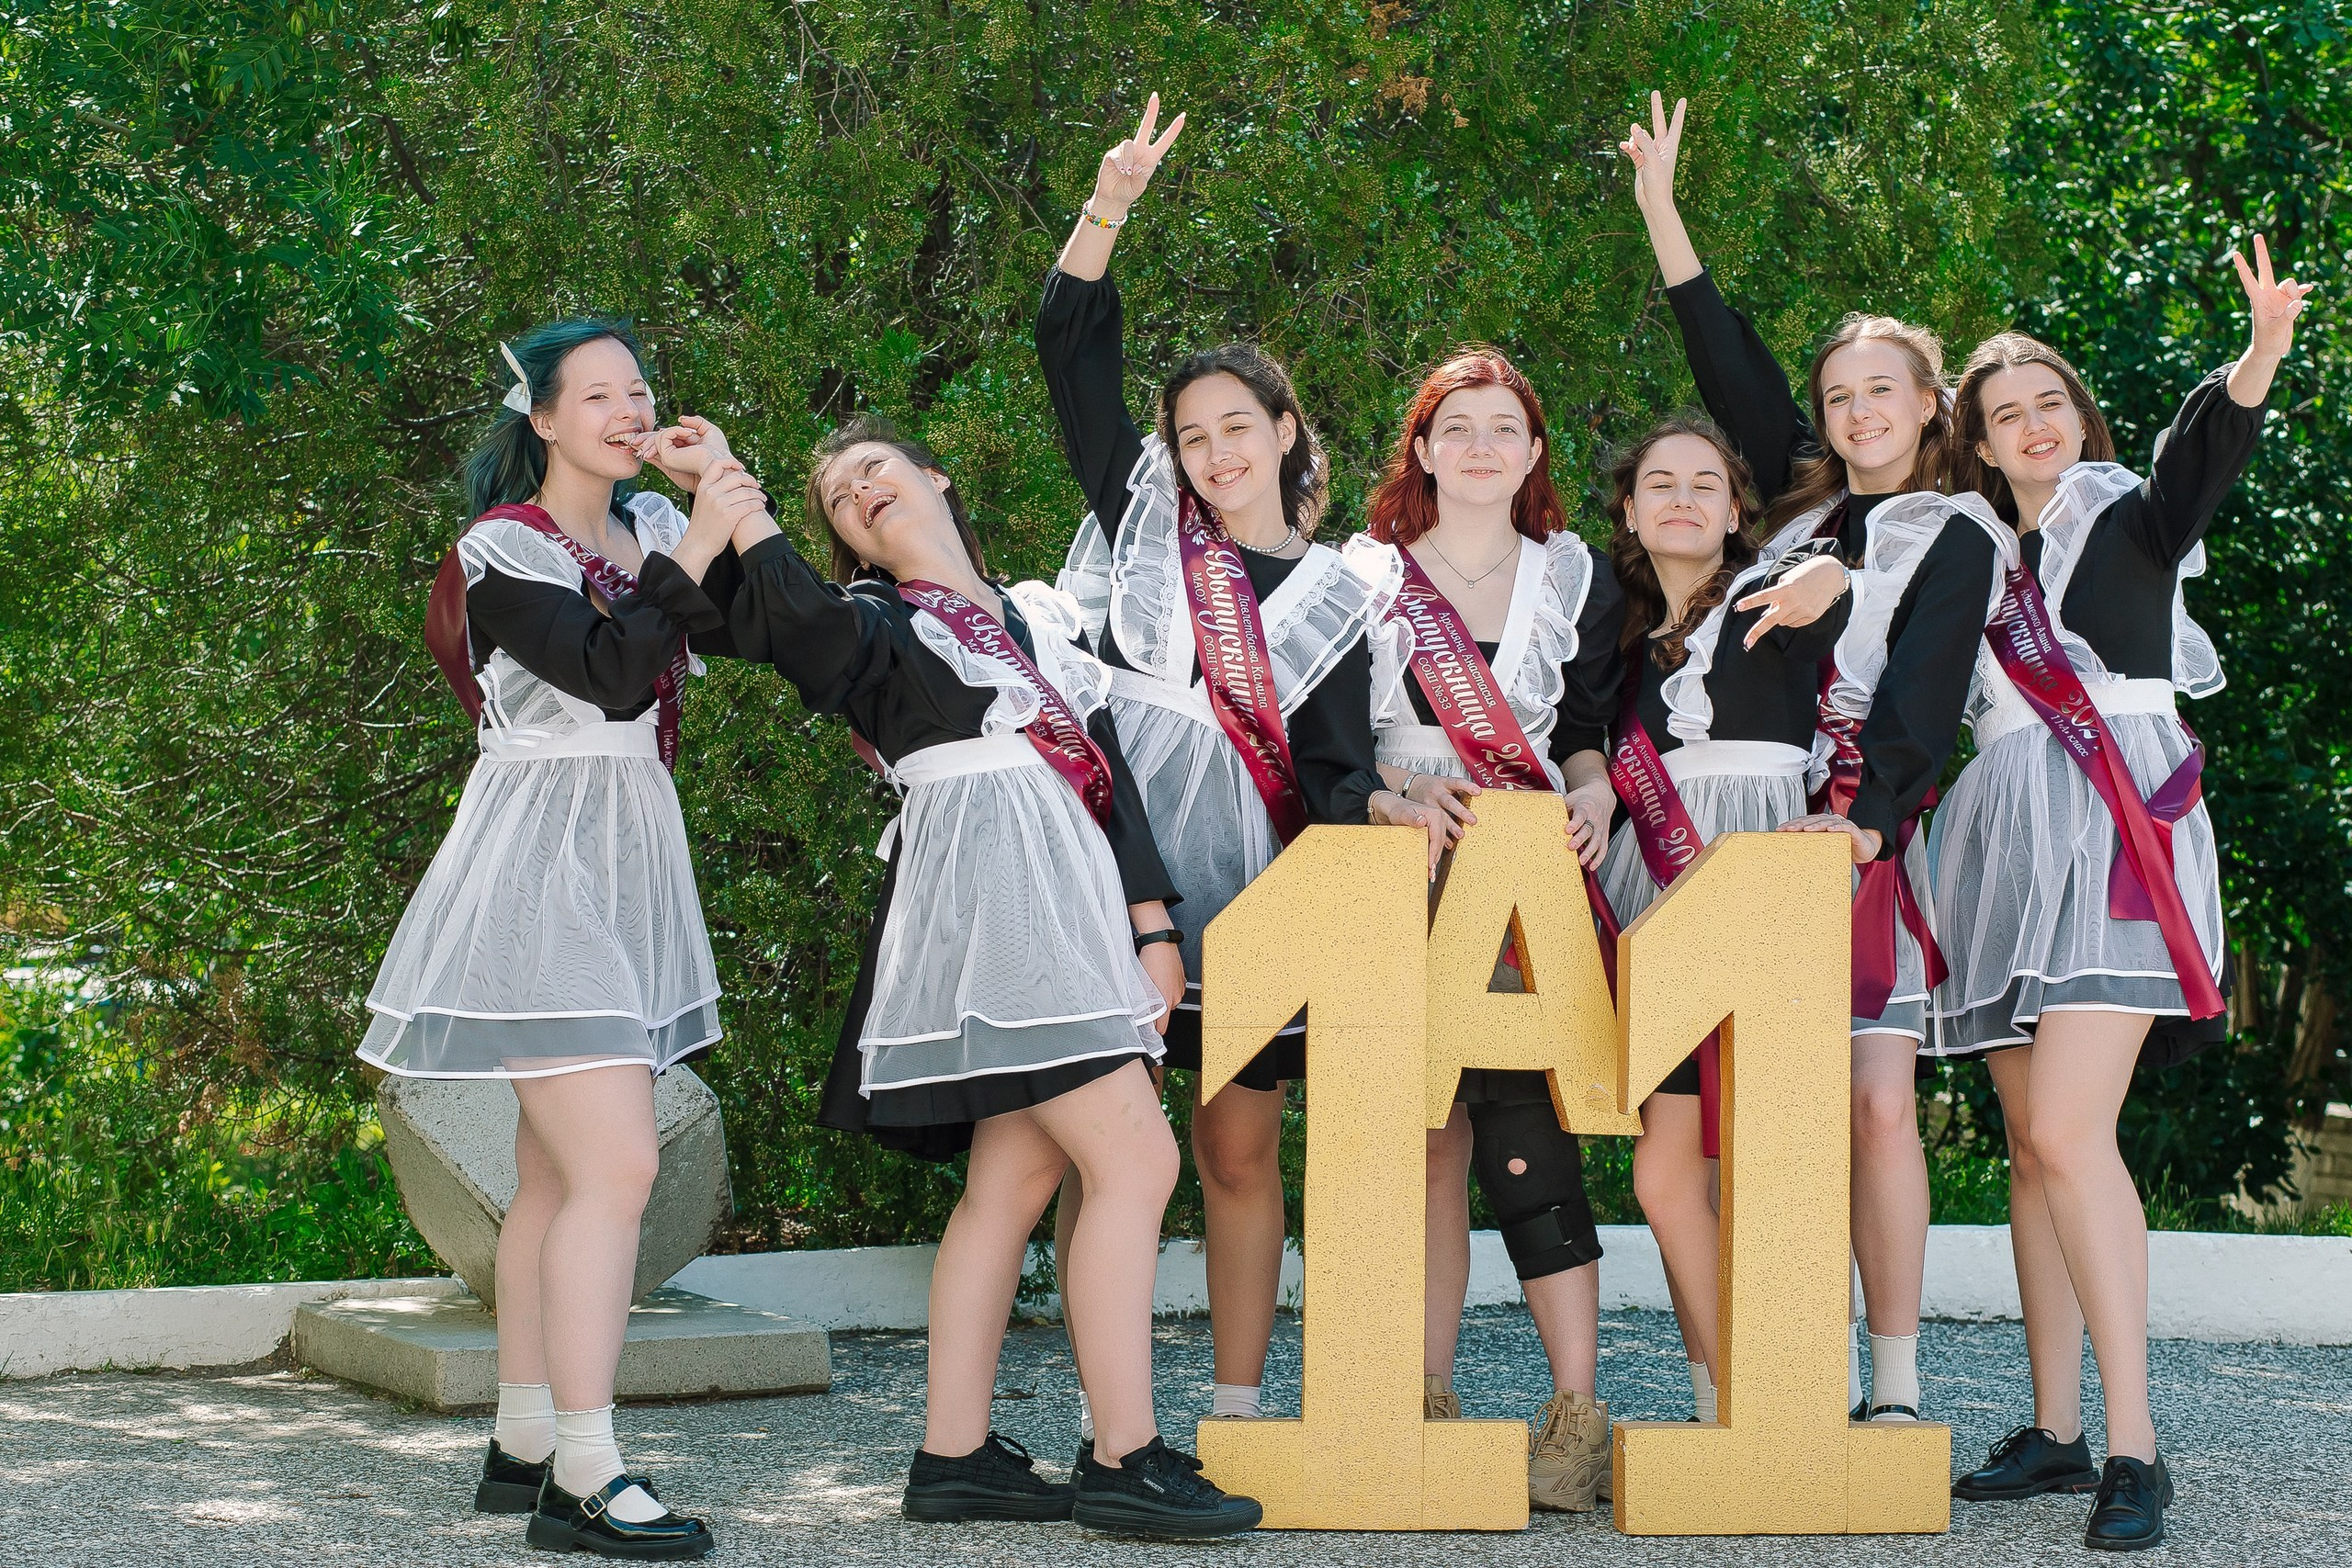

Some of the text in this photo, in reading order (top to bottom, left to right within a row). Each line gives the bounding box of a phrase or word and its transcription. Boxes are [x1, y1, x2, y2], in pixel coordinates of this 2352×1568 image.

[1192, 571, 1224, 694] МАОУ СОШ №33
[1197, 549, 1260, 728] Выпускница
[1236, 592, 1268, 709] Давлетбаева Камила
[2019, 588, 2053, 655] Адаменко Алина
[1418, 657, 1440, 684] СОШ
[1431, 683, 1453, 711] №33
[1438, 611, 1497, 708] Арамянц Анастасия
[1481, 742, 1542, 790] 202
[1636, 744, 1668, 796] Анастасия
[2067, 734, 2089, 757] класс
[1616, 738, 1668, 829] скница
[1622, 781, 1639, 806] №33
[1143, 1477, 1165, 1494] LANCETTI
